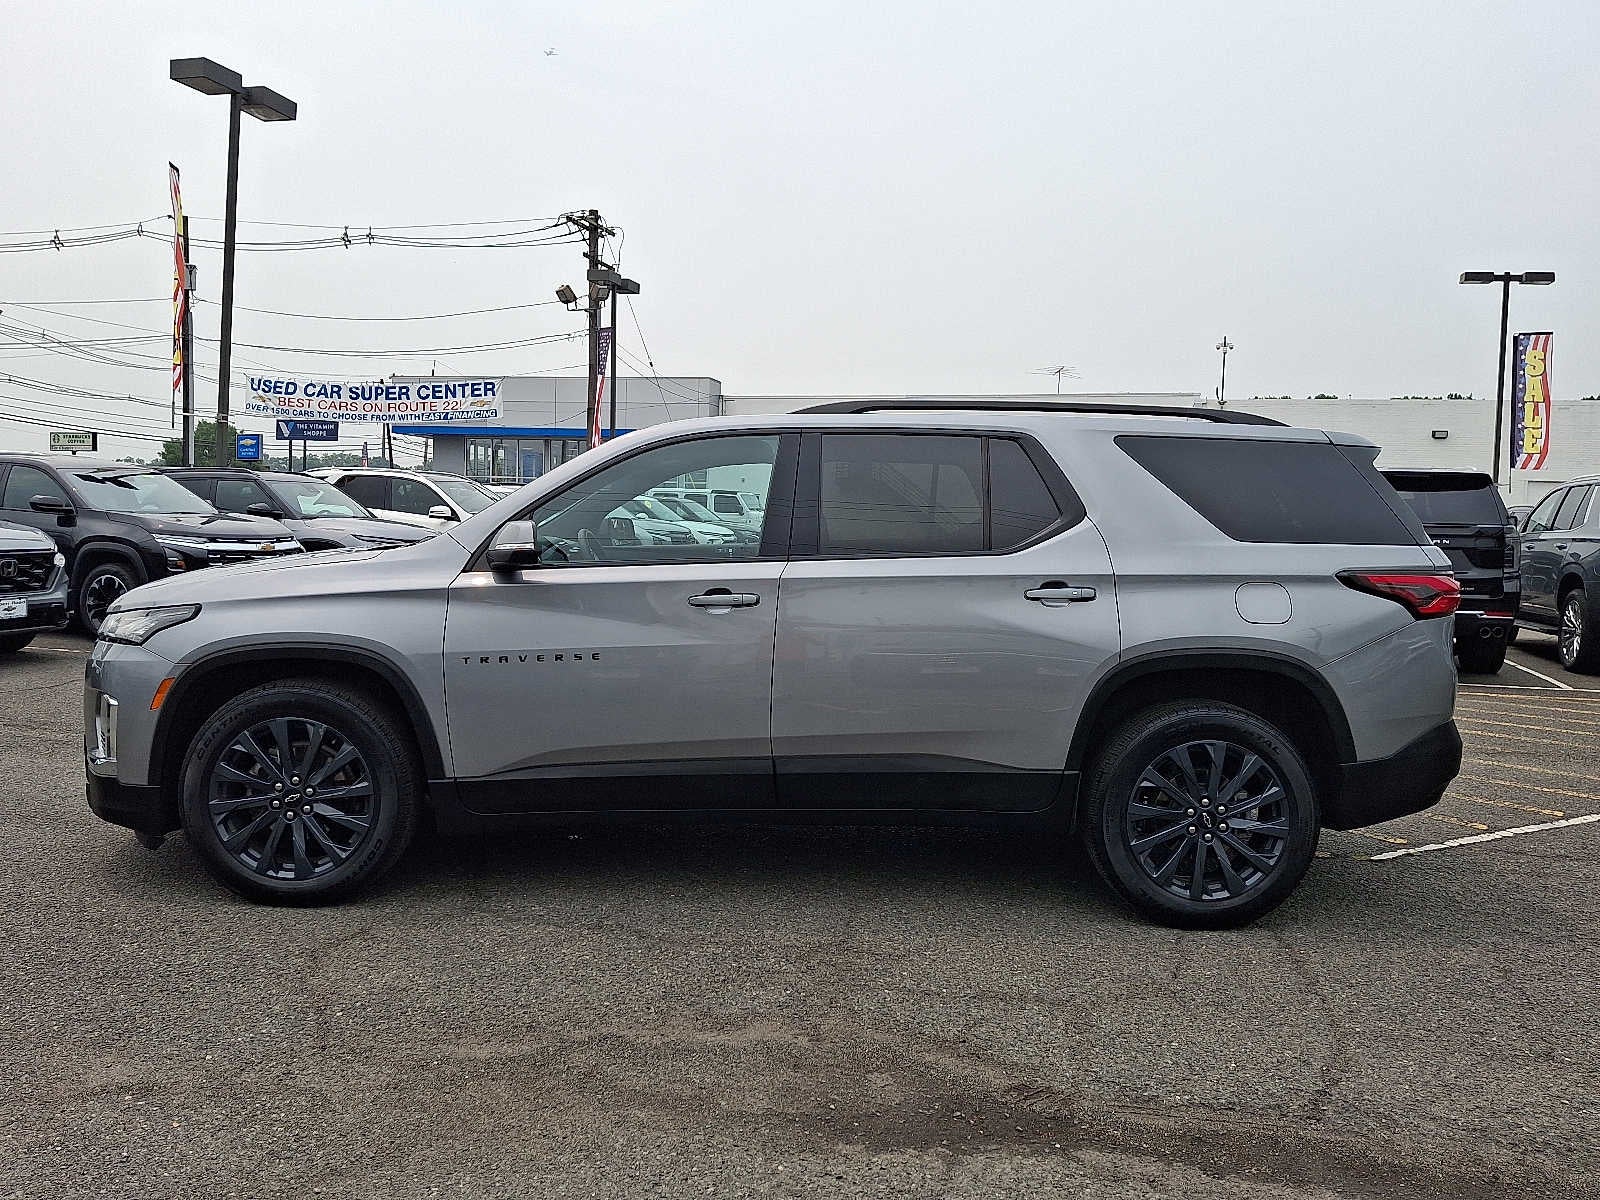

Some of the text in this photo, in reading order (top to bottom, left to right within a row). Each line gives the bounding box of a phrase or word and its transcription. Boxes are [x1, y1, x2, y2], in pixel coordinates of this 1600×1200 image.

[250, 377, 496, 401] USED CAR SUPER CENTER
[277, 396, 463, 413] BEST CARS ON ROUTE 22!
[1523, 349, 1546, 454] SALE
[245, 403, 496, 421] OVER 1500 CARS TO CHOOSE FROM WITH EASY FINANCING
[461, 652, 601, 665] TRAVERSE
